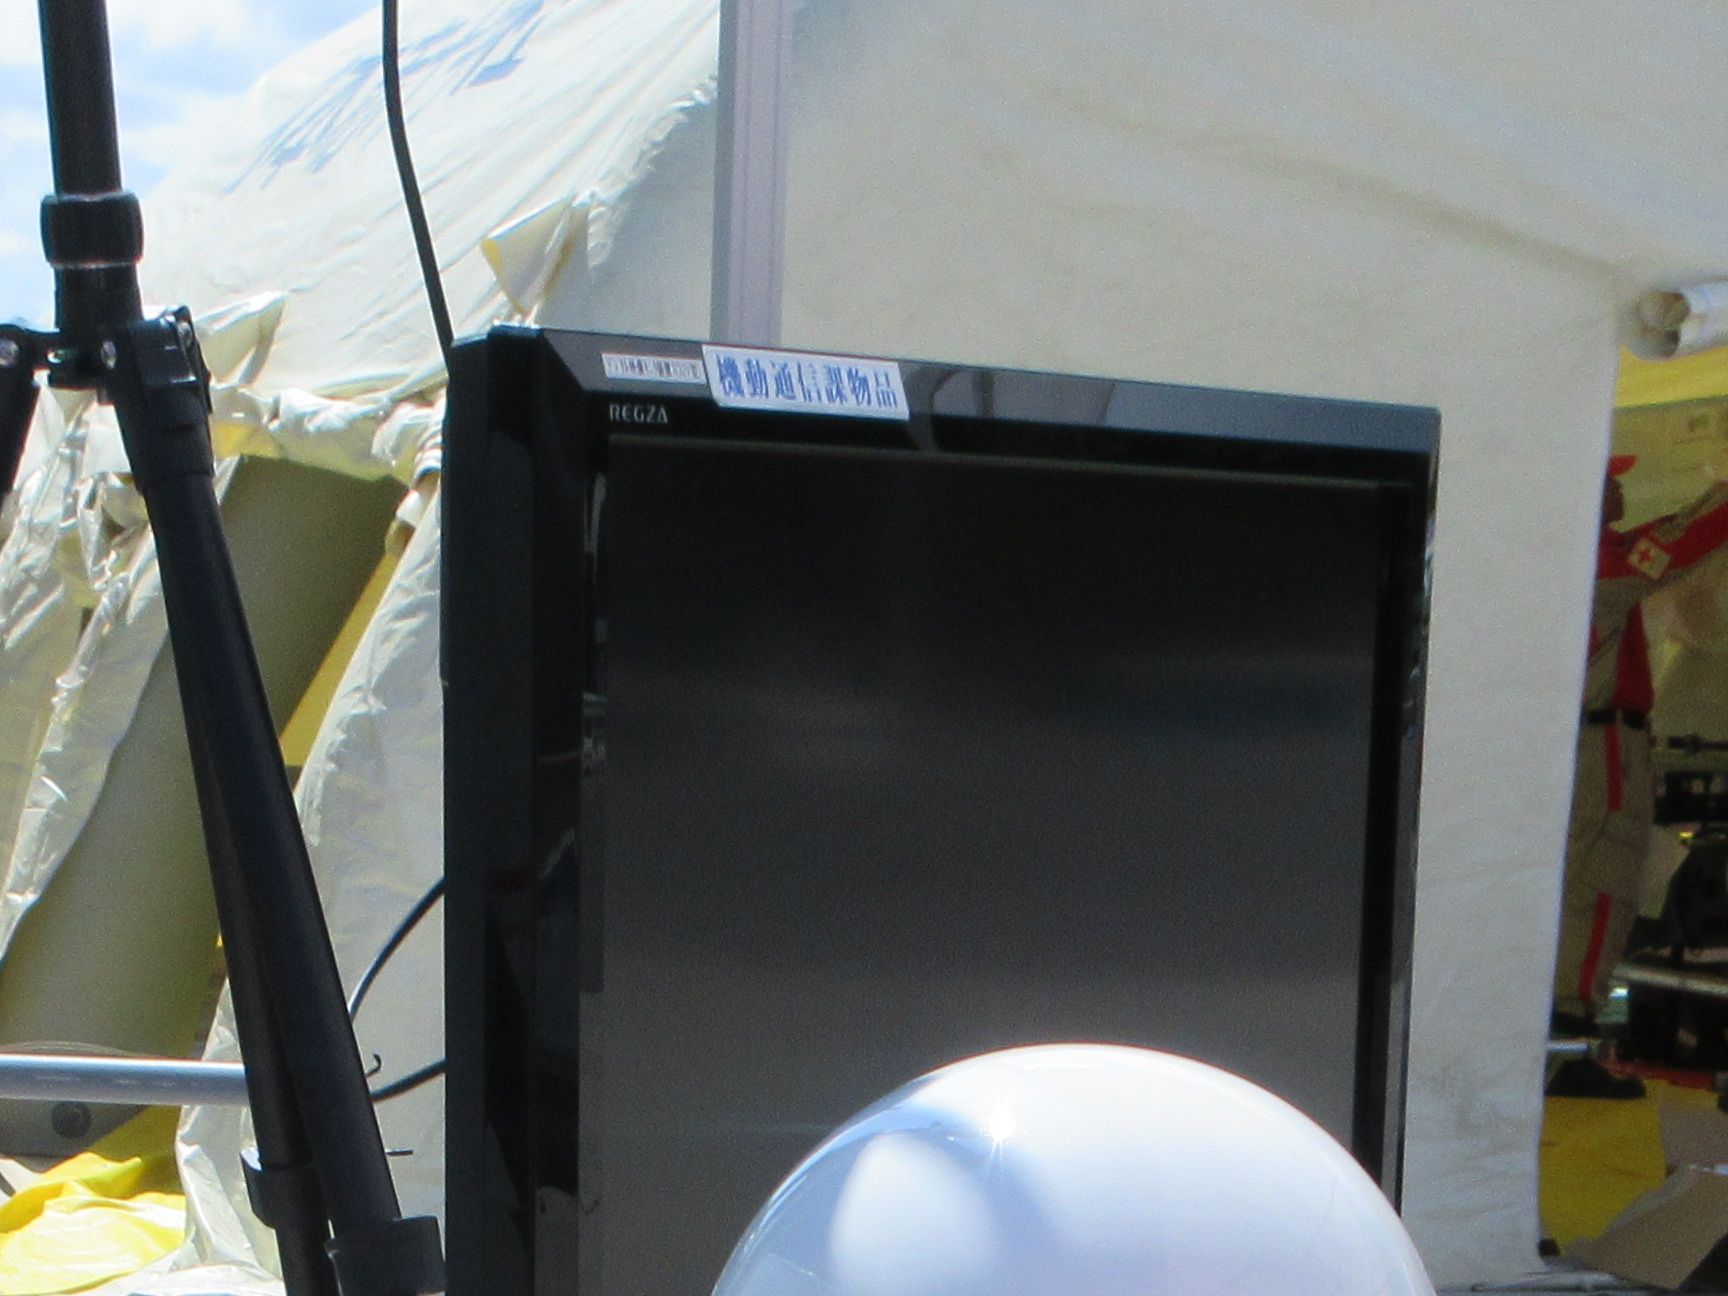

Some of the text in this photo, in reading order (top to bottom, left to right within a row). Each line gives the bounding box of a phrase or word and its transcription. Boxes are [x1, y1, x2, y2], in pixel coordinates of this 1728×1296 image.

[716, 353, 898, 408] 機動通信課物品
[609, 403, 668, 423] REGZA
